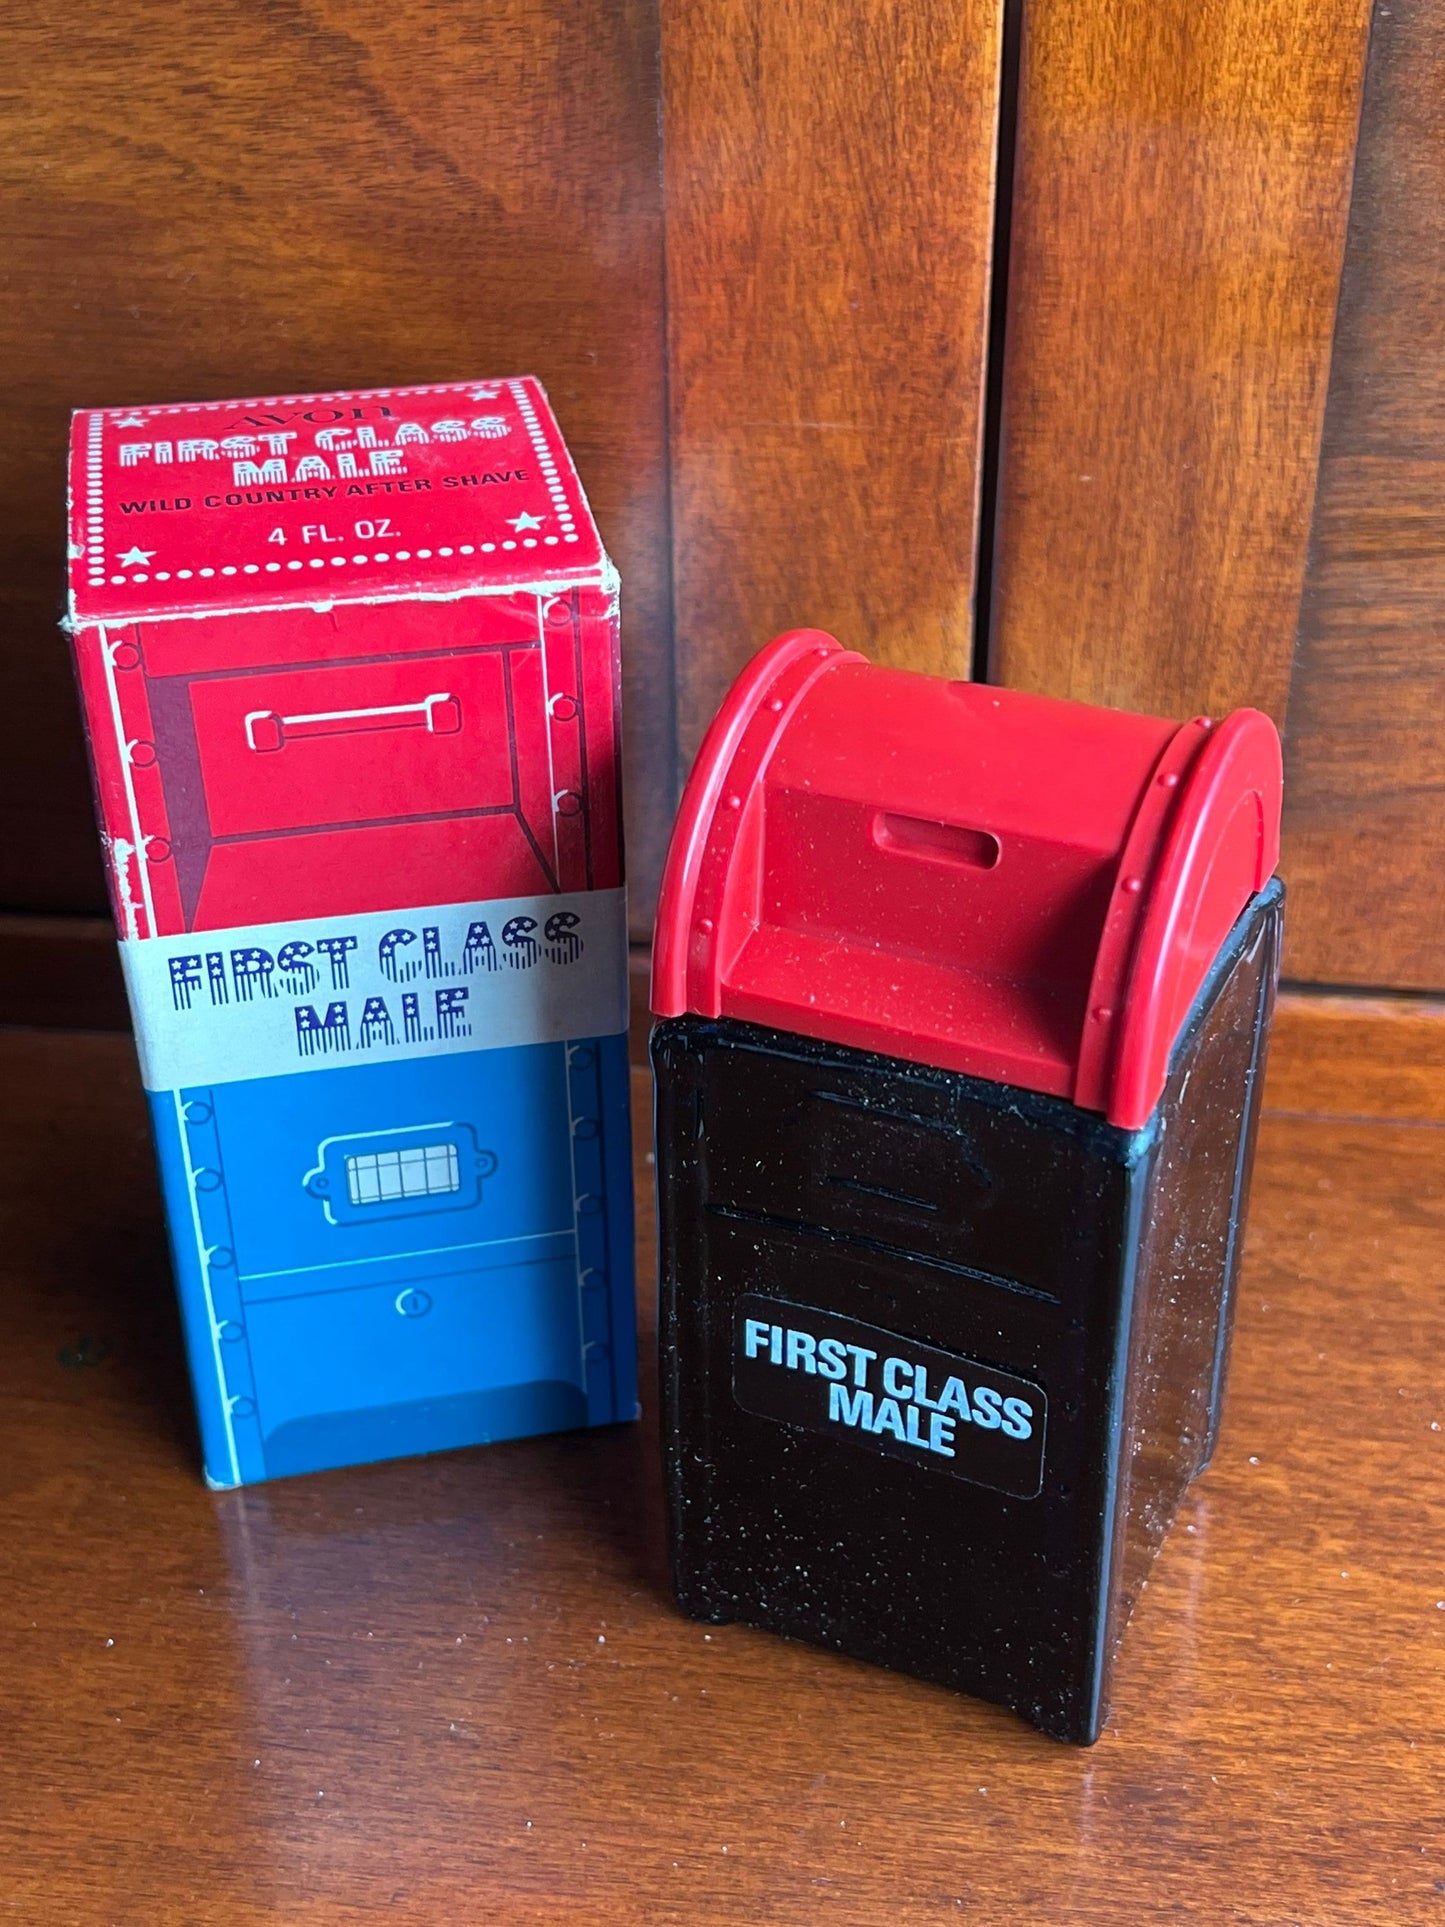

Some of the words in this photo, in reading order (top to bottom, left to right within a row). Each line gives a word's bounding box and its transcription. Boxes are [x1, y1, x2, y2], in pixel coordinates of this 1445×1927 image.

[119, 430, 298, 467] FIRST
[314, 416, 513, 452] CLASS
[233, 449, 409, 487] MALE
[119, 497, 192, 515] WILD
[204, 484, 338, 508] COUNTRY
[346, 478, 433, 497] AFTER
[442, 469, 530, 489] SHAVE
[267, 527, 288, 547] 4
[302, 523, 345, 544] FL.
[354, 518, 402, 540] OZ.
[167, 934, 359, 1011] FIRST
[378, 911, 585, 984] CLASS
[294, 986, 473, 1057] MALE
[746, 1319, 878, 1388] FIRST
[883, 1357, 1033, 1440] CLASS
[829, 1383, 956, 1457] MALE
